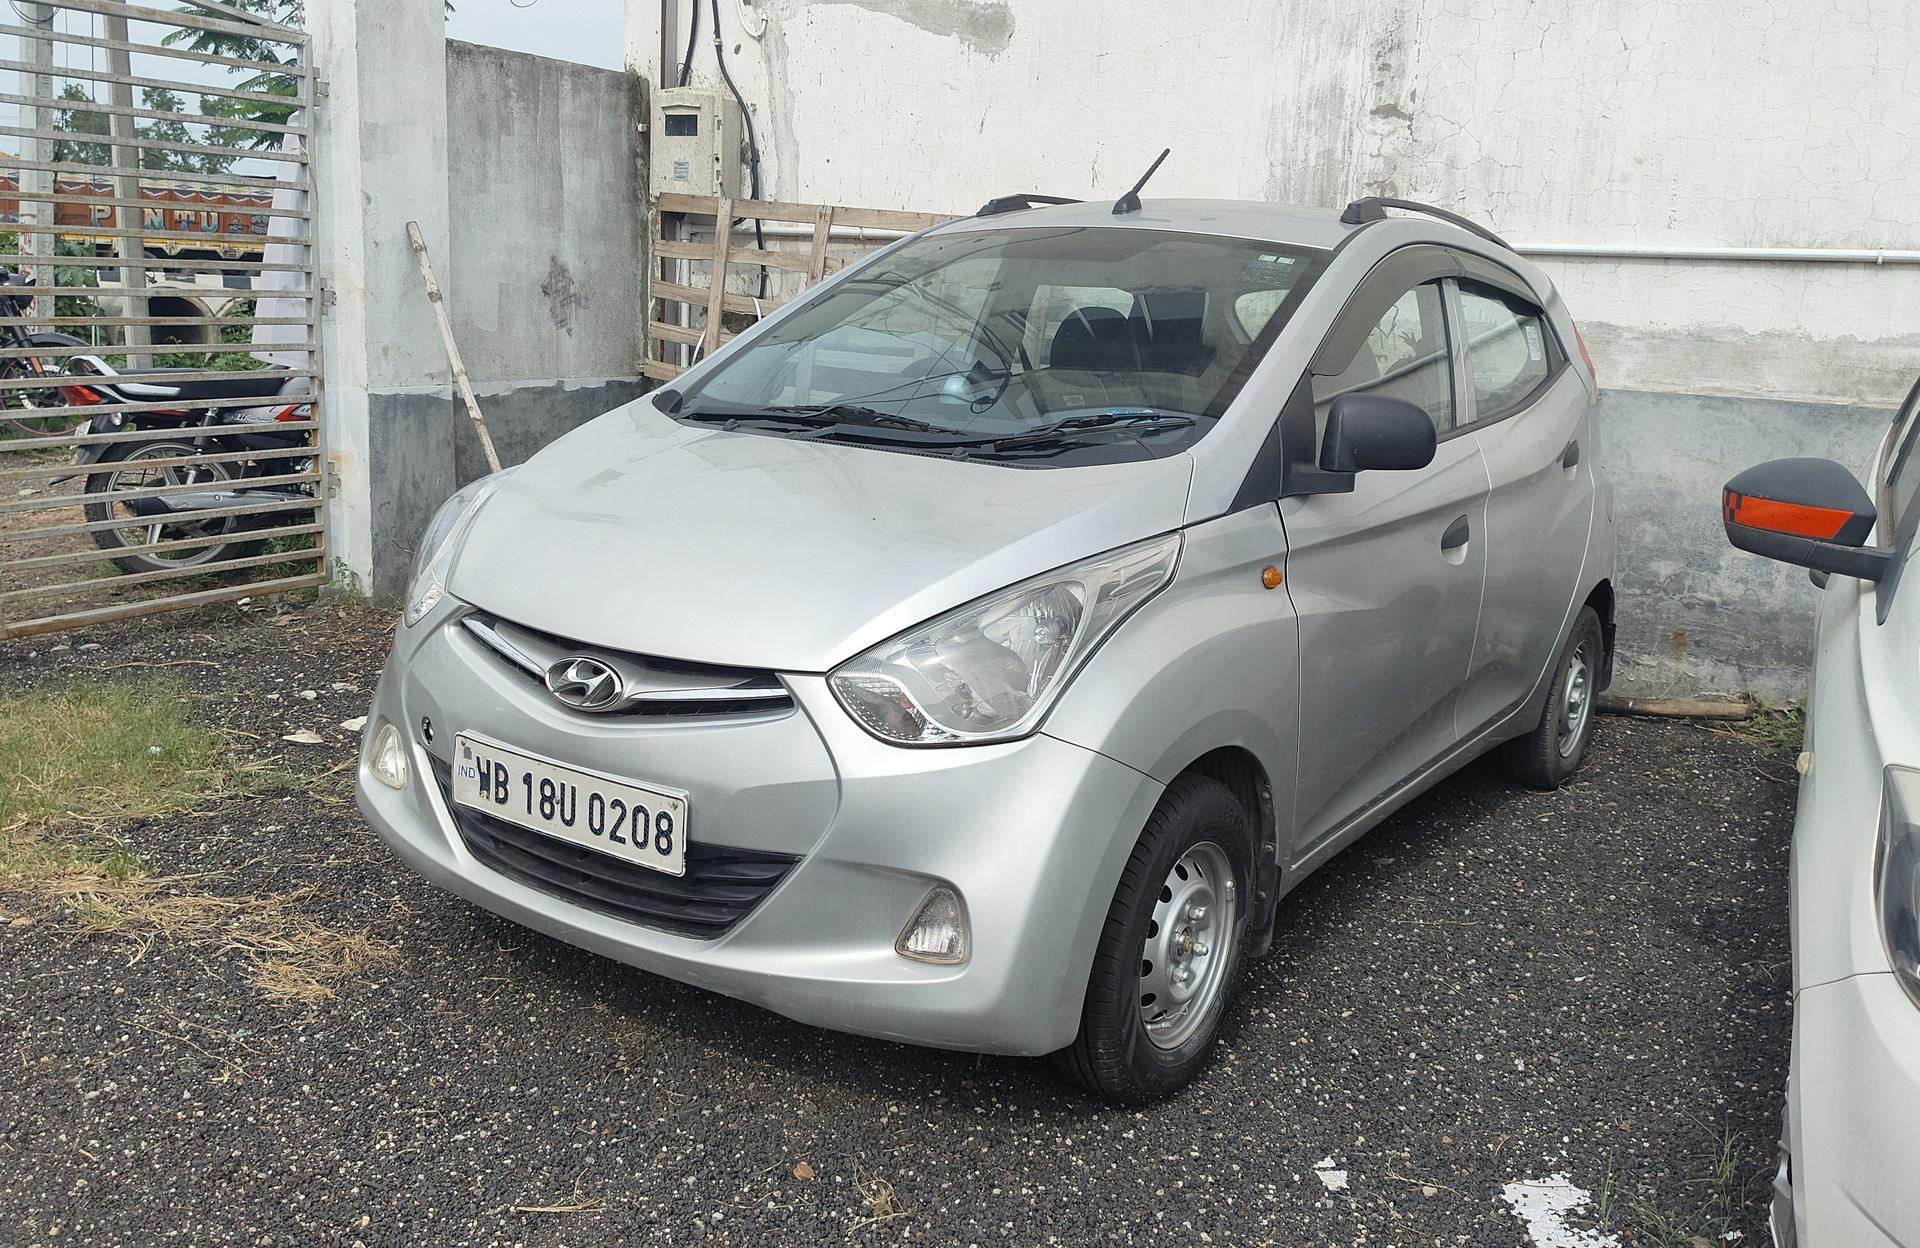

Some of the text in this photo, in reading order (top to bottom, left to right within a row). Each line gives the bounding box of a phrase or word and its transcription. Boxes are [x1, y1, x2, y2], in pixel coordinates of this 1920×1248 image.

[88, 204, 220, 233] PNTU
[458, 764, 476, 779] IND
[476, 756, 674, 856] WB 18U 0208
